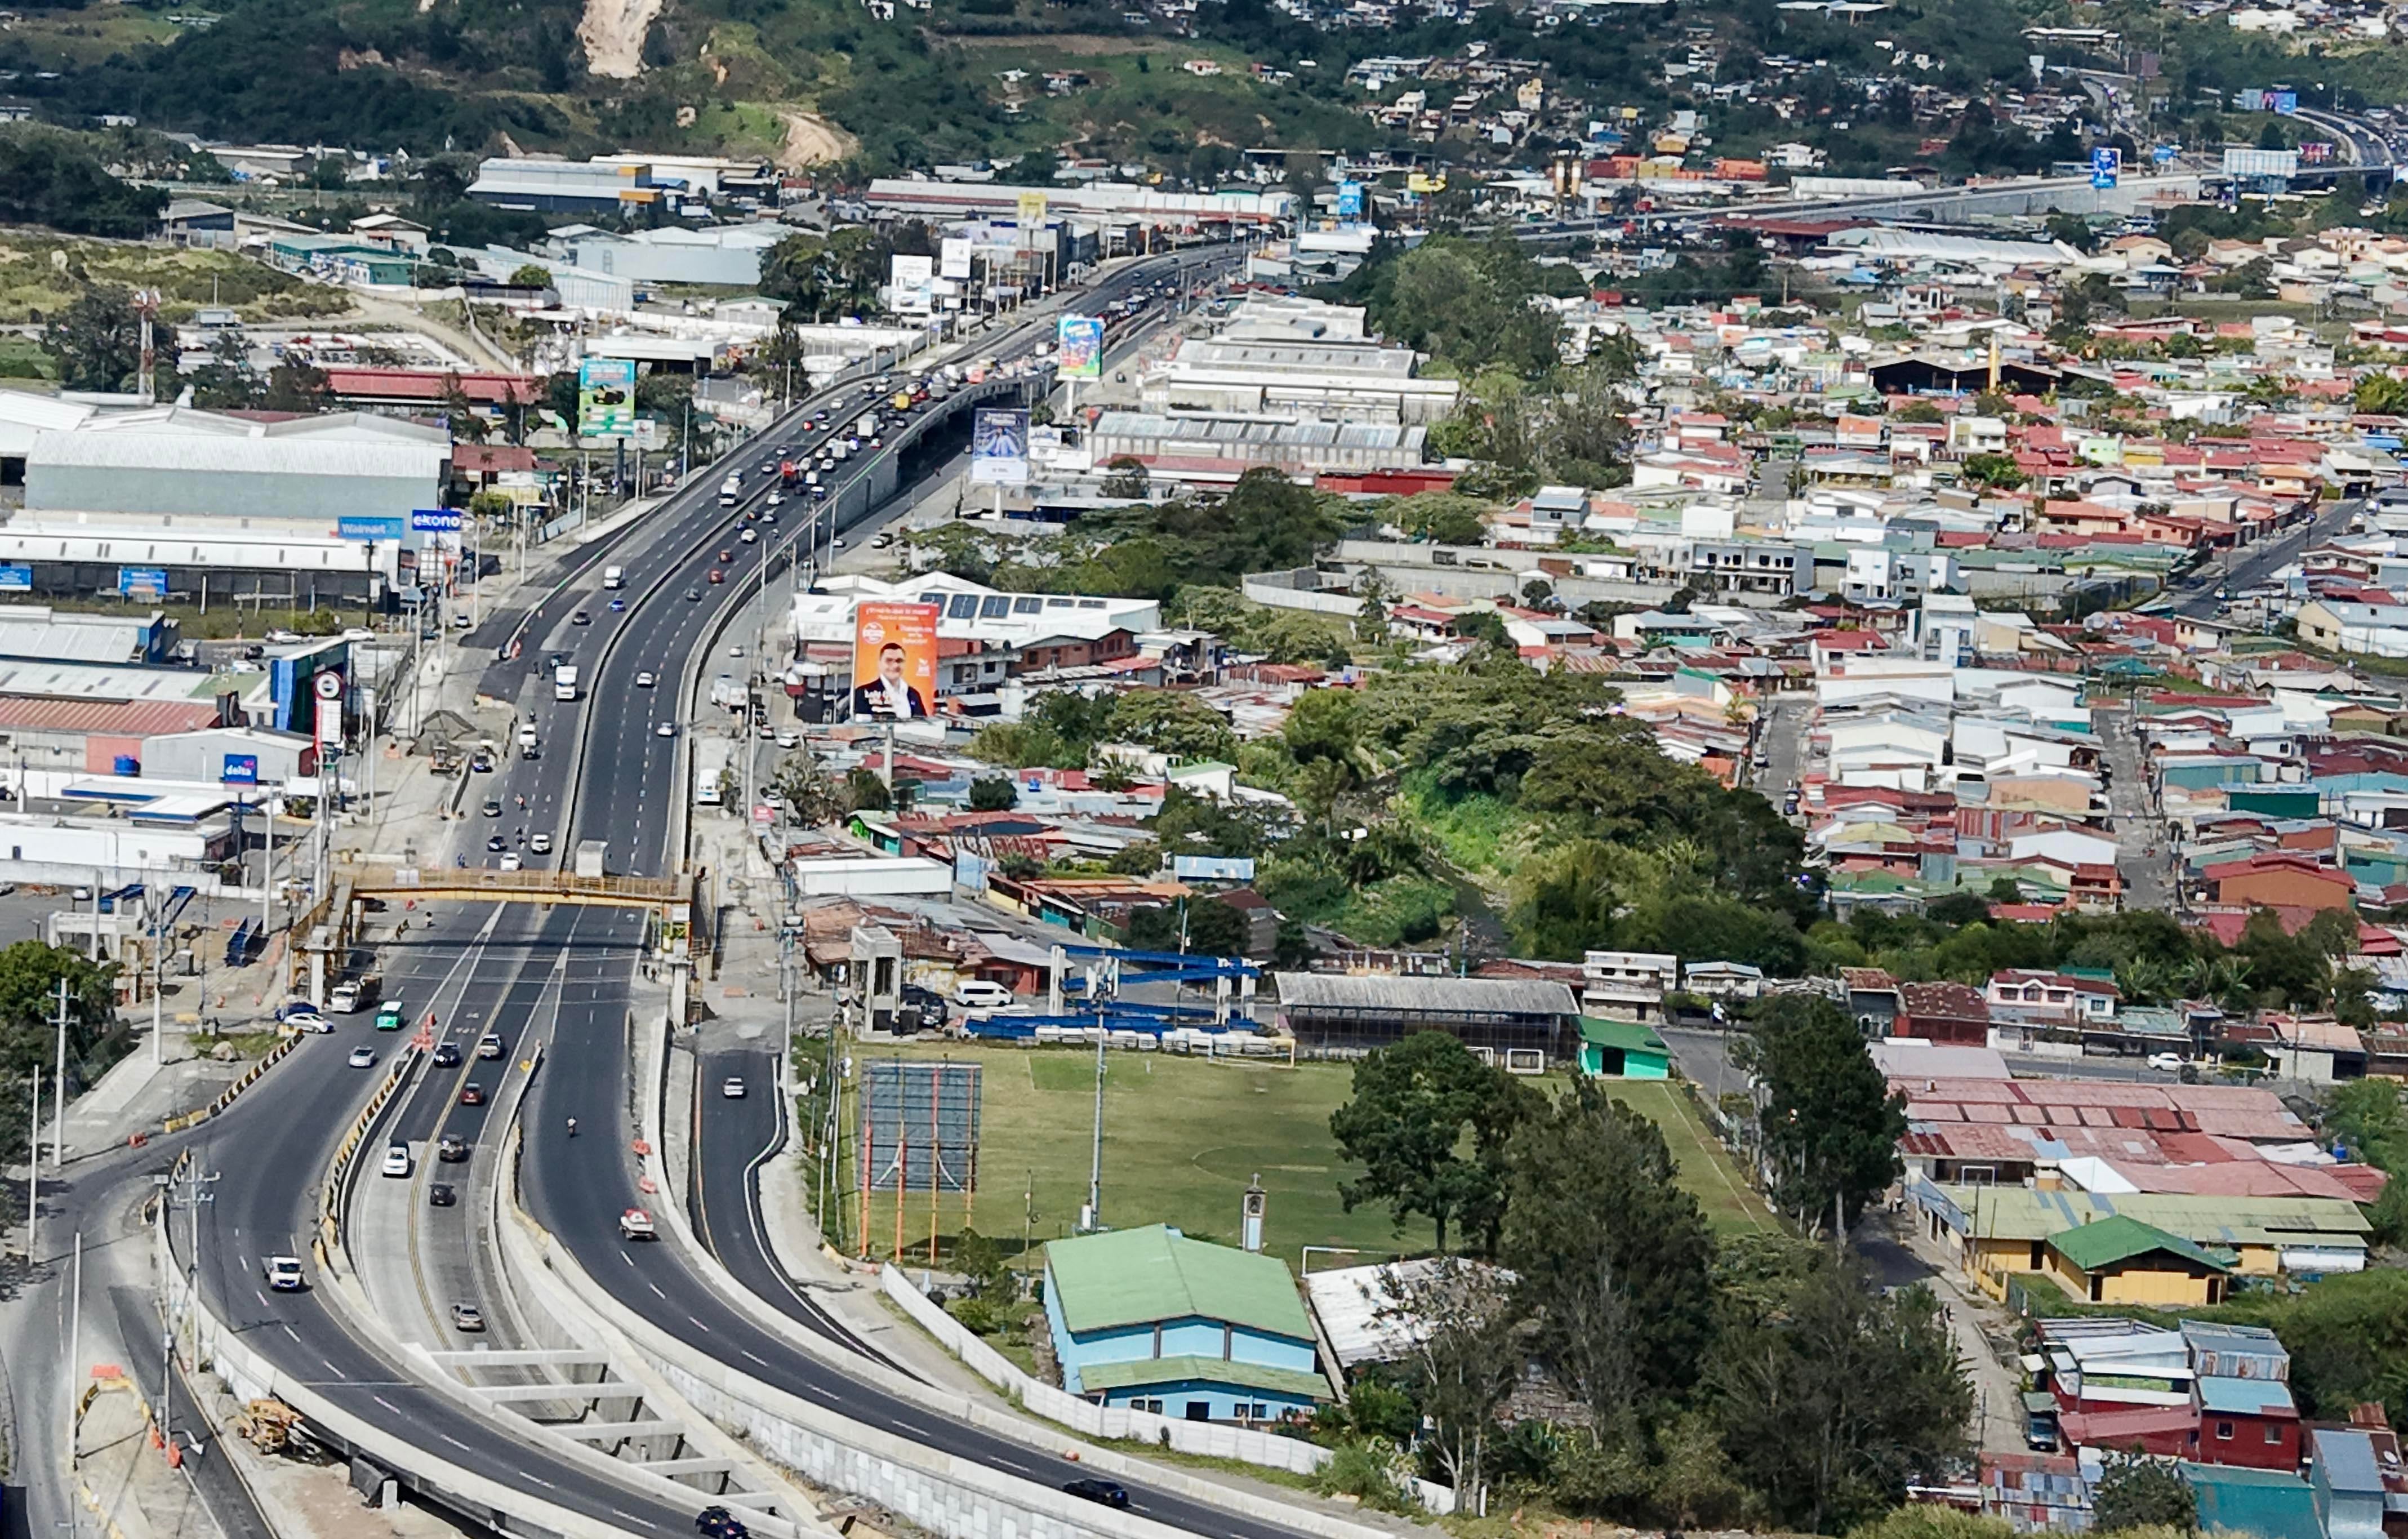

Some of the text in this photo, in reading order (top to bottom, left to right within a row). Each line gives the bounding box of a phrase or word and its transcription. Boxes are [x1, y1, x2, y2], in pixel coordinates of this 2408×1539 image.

[413, 514, 461, 528] ekono
[341, 523, 386, 534] Walmart
[225, 764, 252, 776] delta
